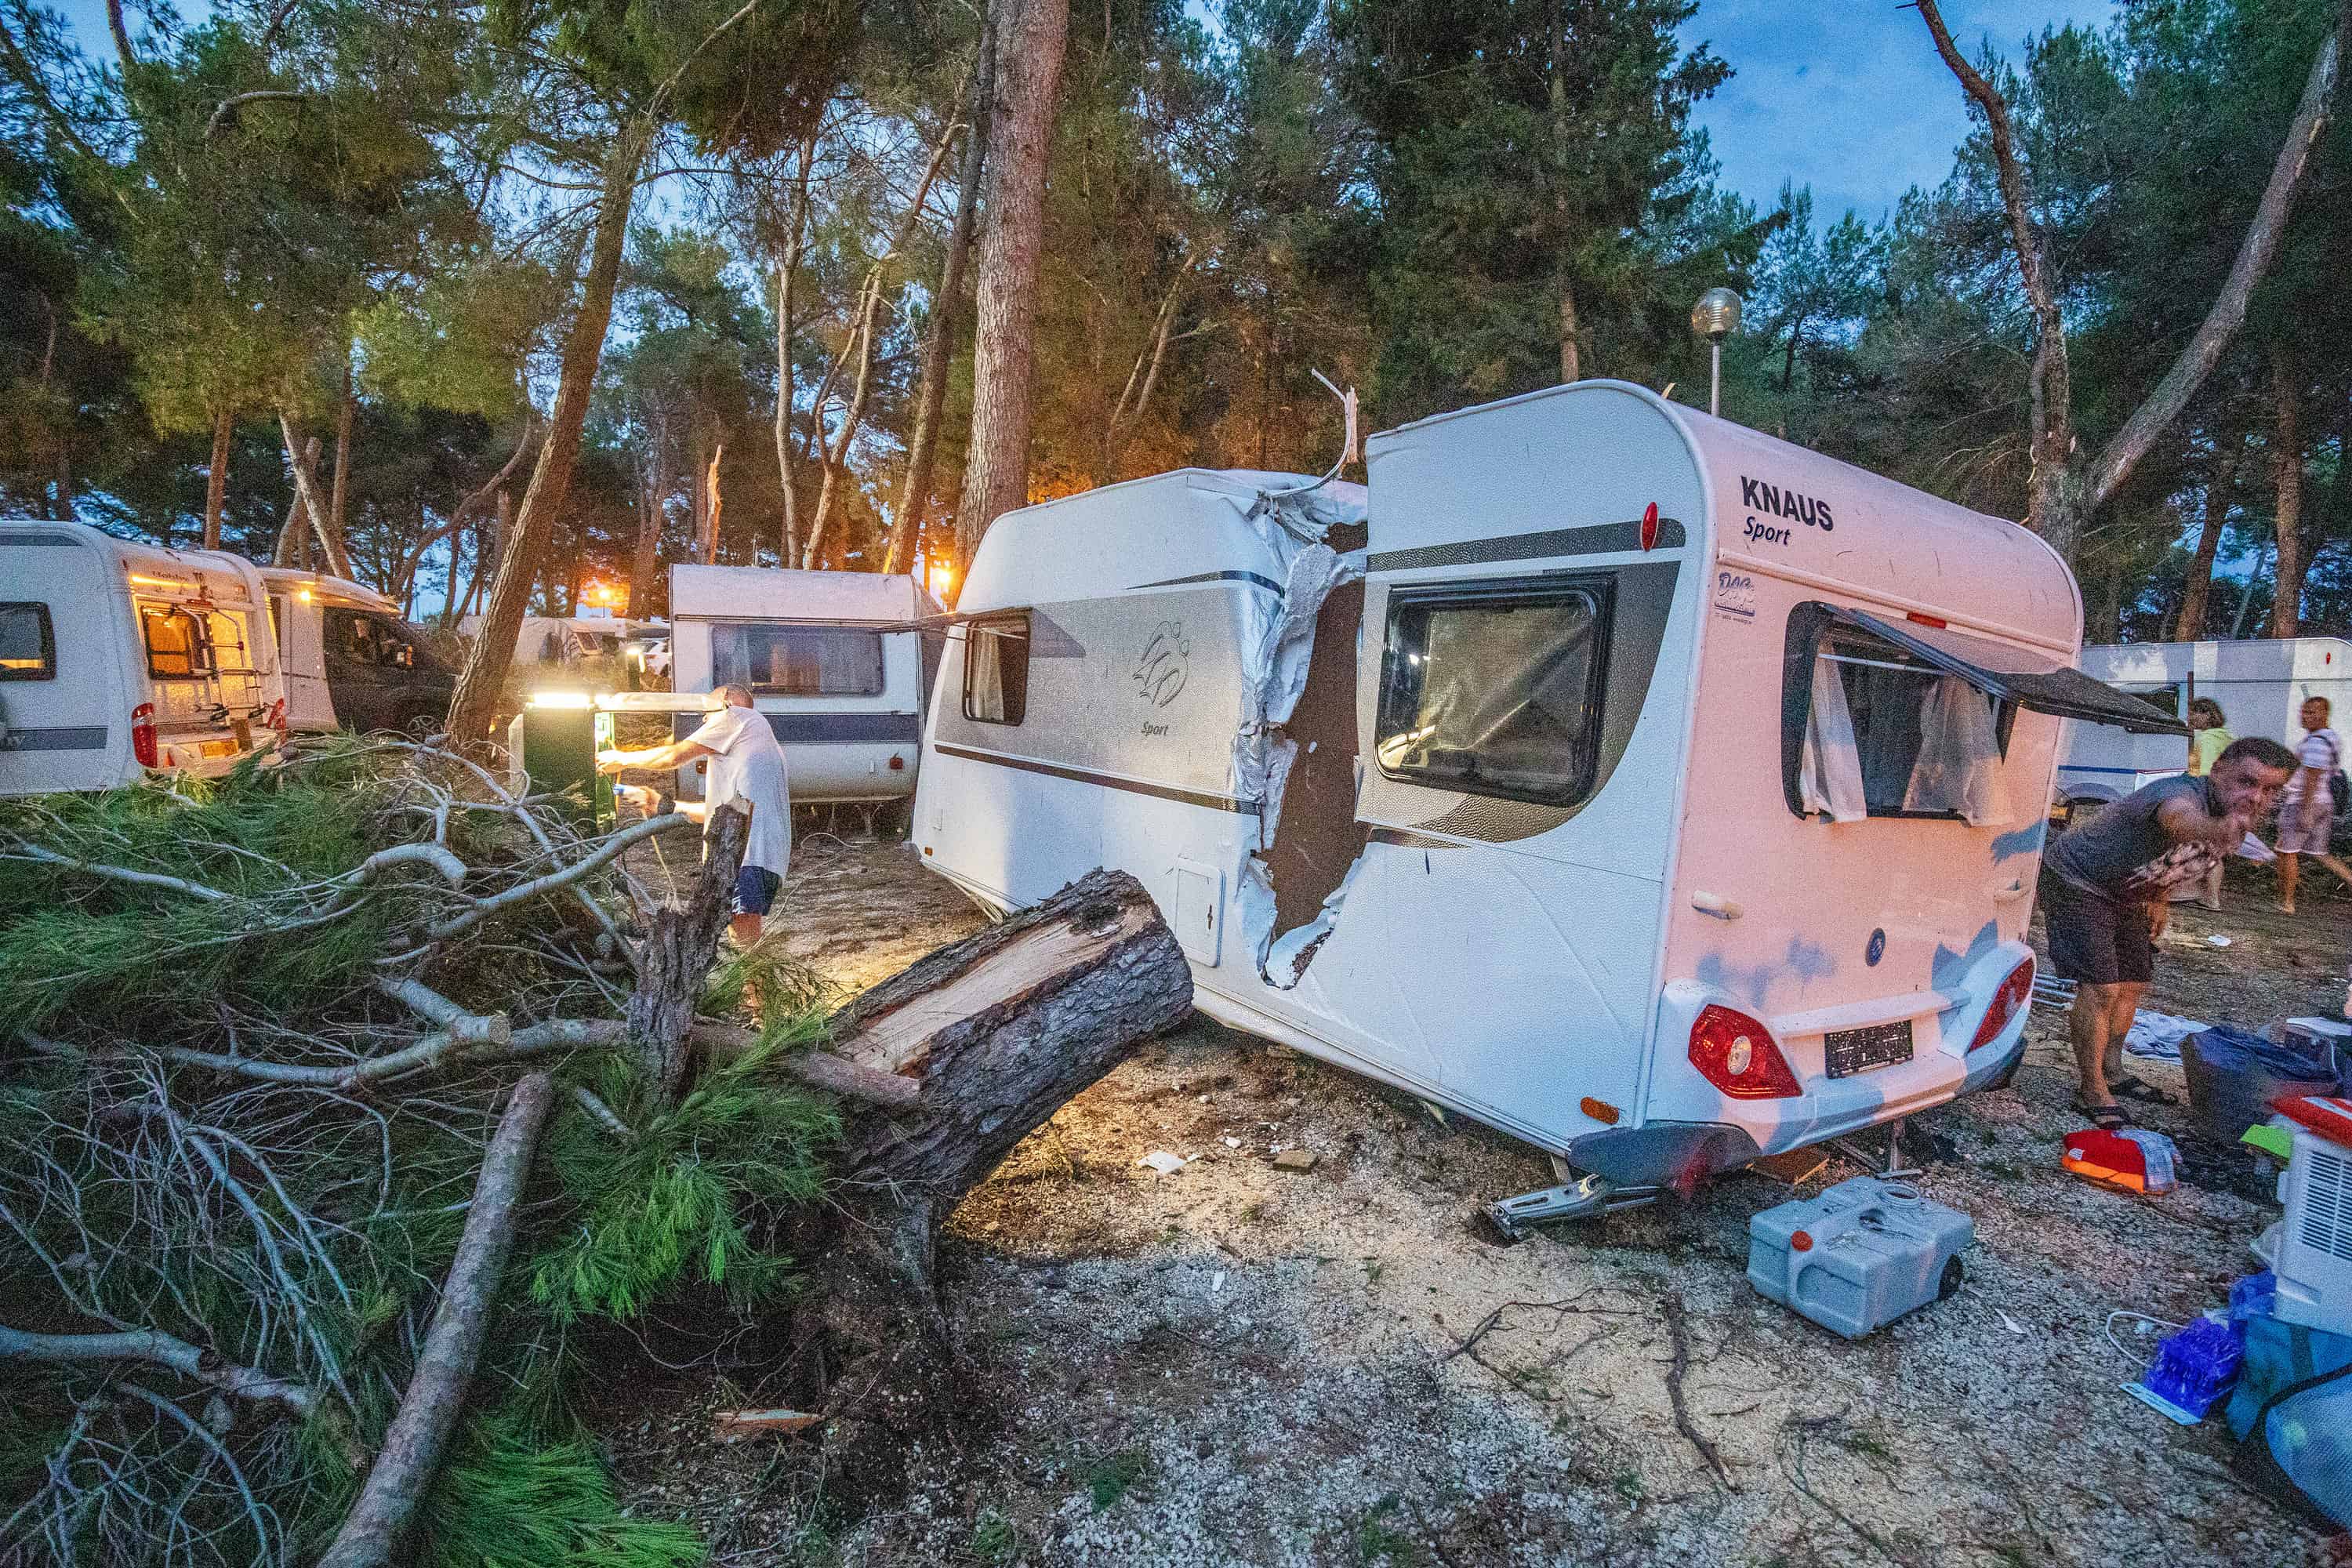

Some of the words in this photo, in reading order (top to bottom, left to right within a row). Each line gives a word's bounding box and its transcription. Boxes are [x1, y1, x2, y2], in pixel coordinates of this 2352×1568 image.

[1740, 475, 1834, 532] KNAUS
[1744, 516, 1791, 545] Sport
[1142, 721, 1169, 736] Sport
